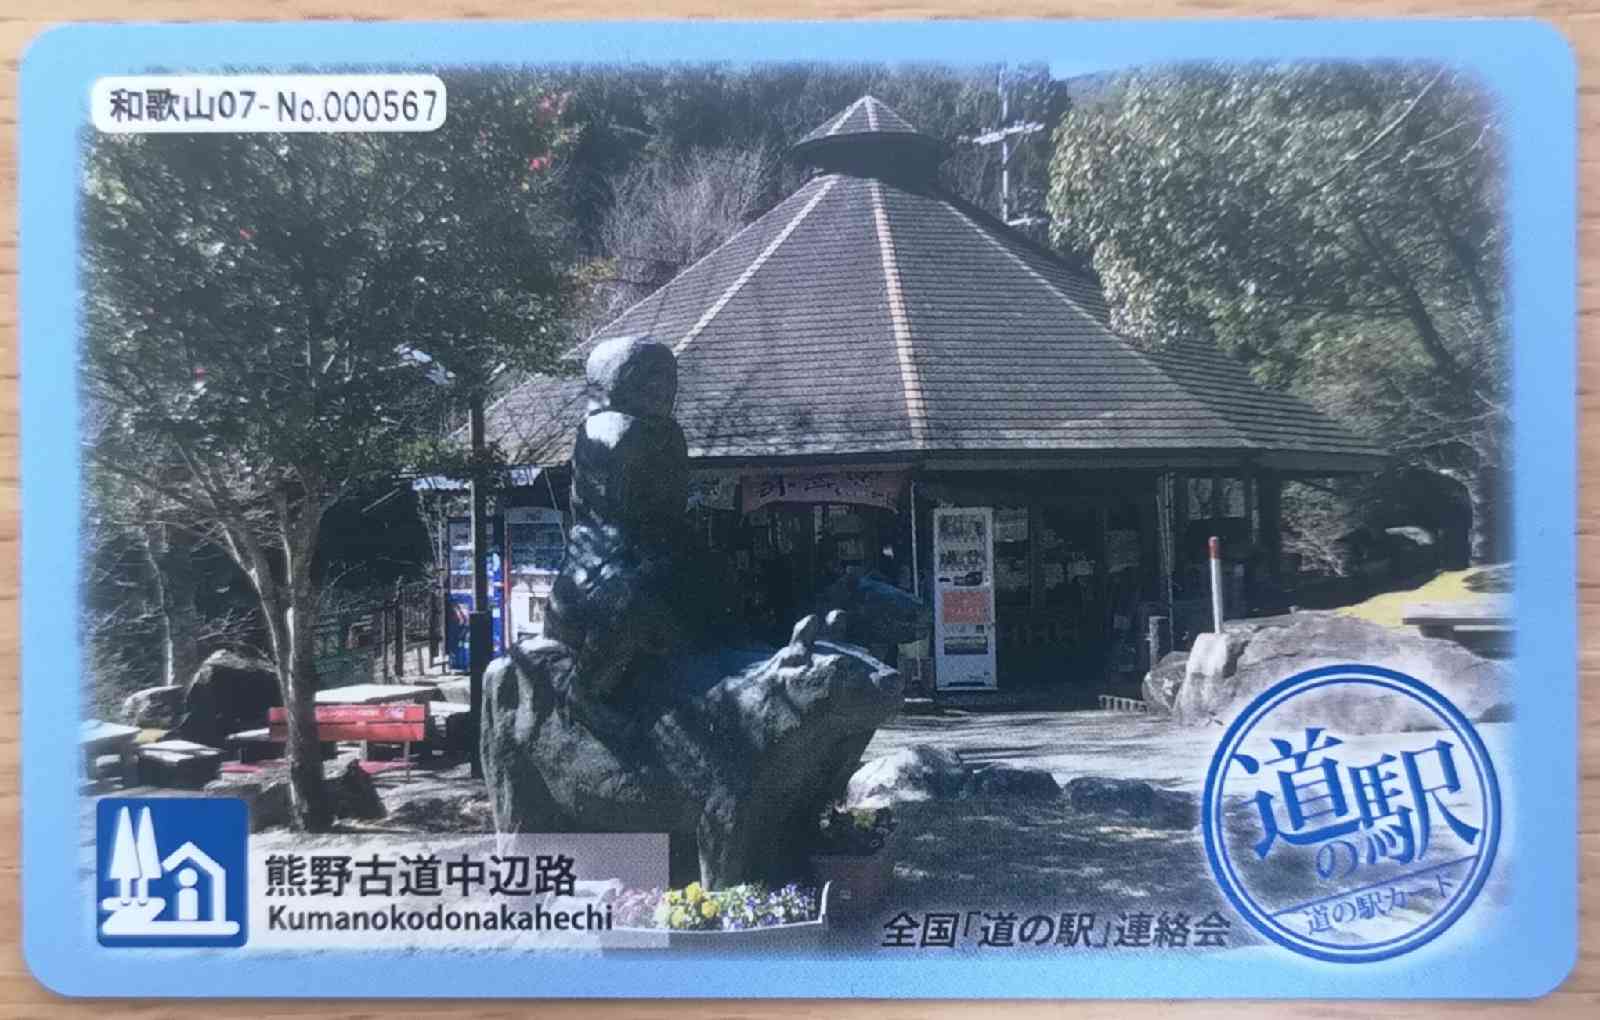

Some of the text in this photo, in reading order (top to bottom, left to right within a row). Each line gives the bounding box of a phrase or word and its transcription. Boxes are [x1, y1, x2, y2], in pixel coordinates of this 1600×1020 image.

[264, 854, 577, 898] 熊野古道中辺路
[267, 904, 613, 932] Kumanokodonakahechi
[881, 911, 1232, 950] 全国「道の駅」連絡会
